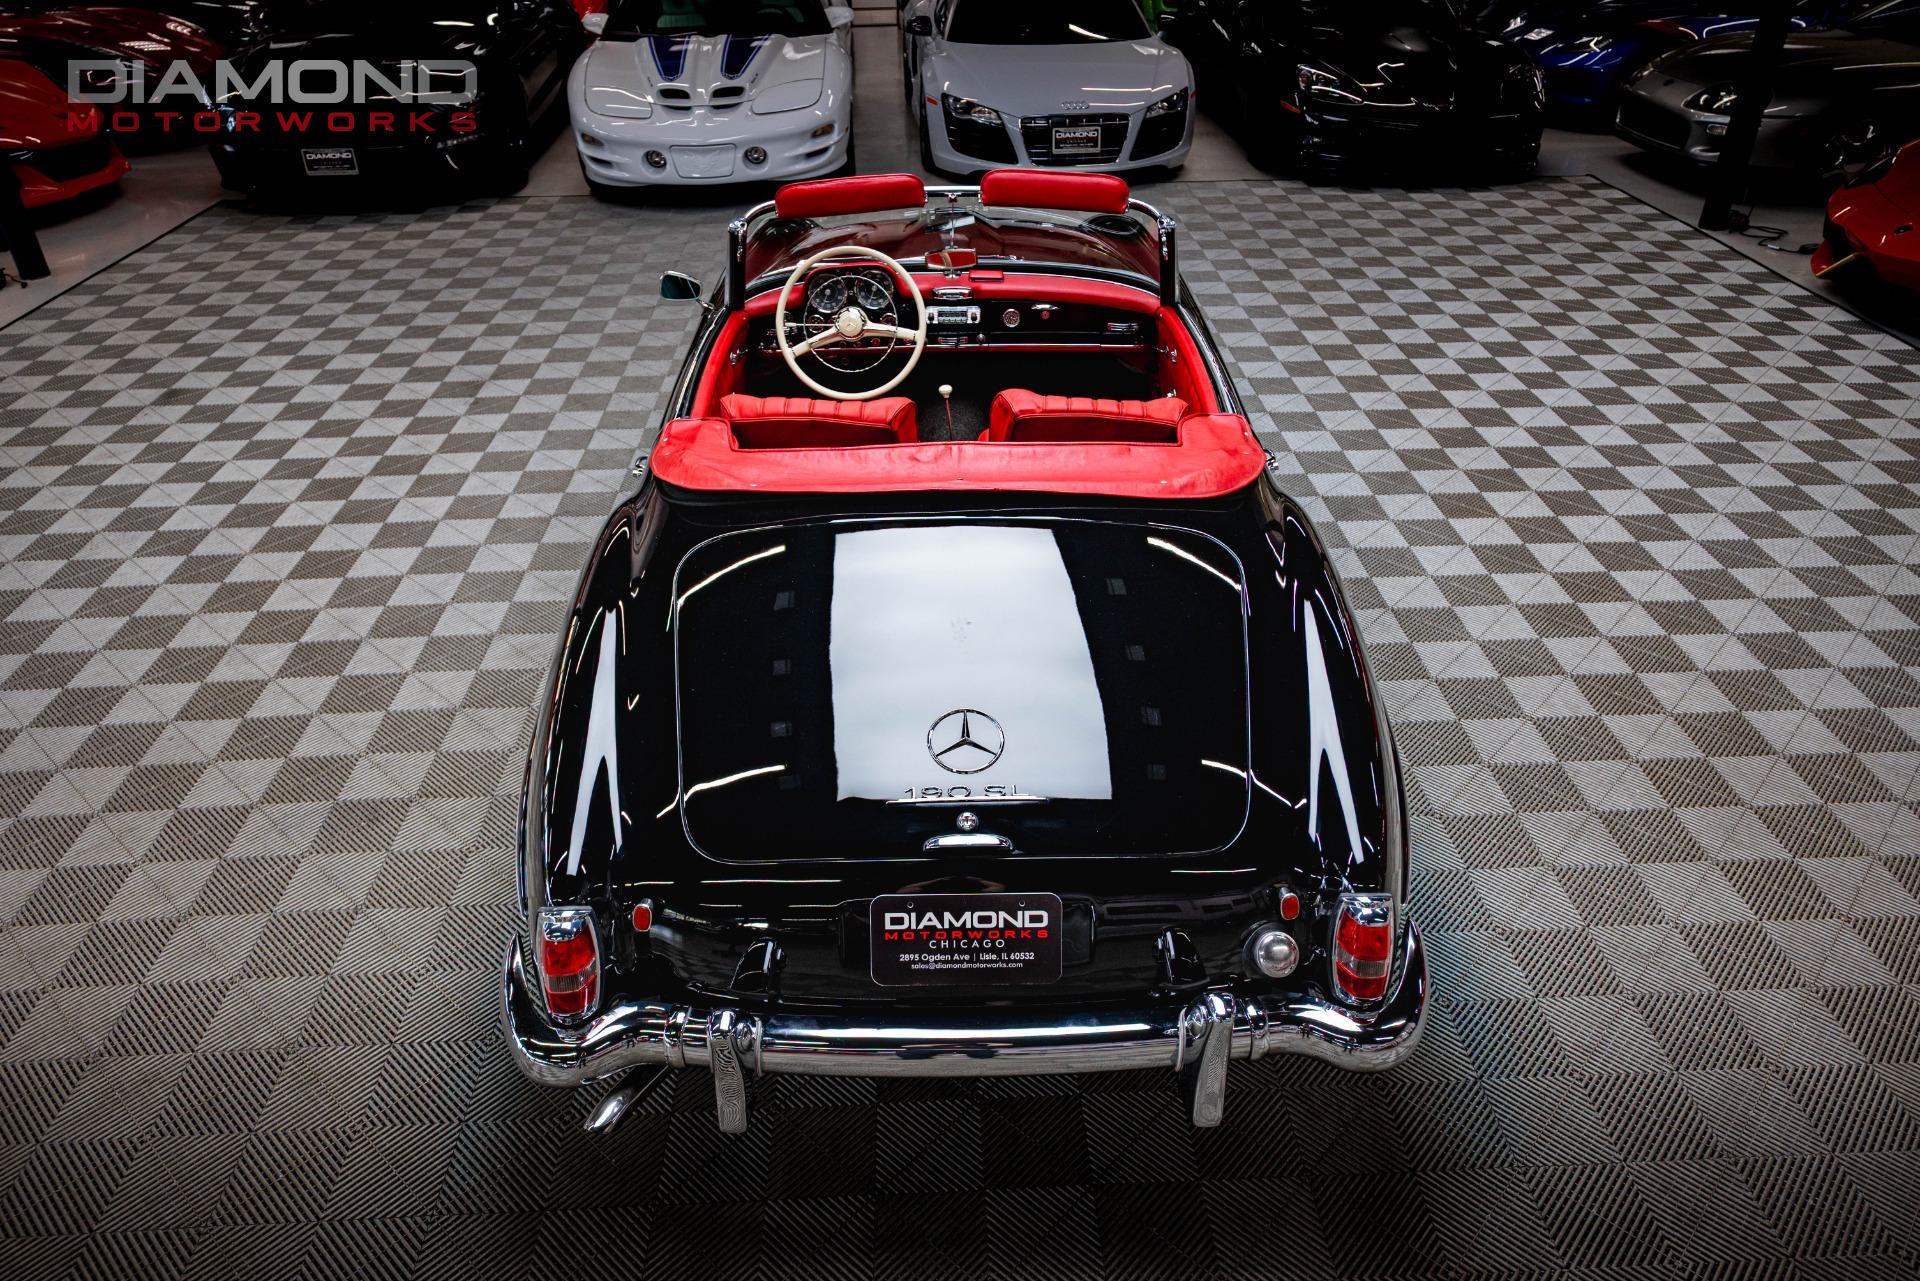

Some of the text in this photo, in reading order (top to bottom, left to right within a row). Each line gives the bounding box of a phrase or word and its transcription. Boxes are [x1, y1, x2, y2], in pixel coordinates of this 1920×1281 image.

[904, 785, 1030, 798] 190 SL
[884, 910, 1048, 930] DIAMOND
[884, 930, 1049, 940] MOTORWORKS
[929, 940, 1005, 949] CHICAGO
[899, 954, 919, 962] 2895
[922, 953, 951, 962] Ogden
[980, 952, 1000, 962] Lisle,
[1002, 952, 1009, 960] IL
[1010, 952, 1035, 960] 60532
[912, 962, 1023, 970] sales@diamondmotorworks.com
